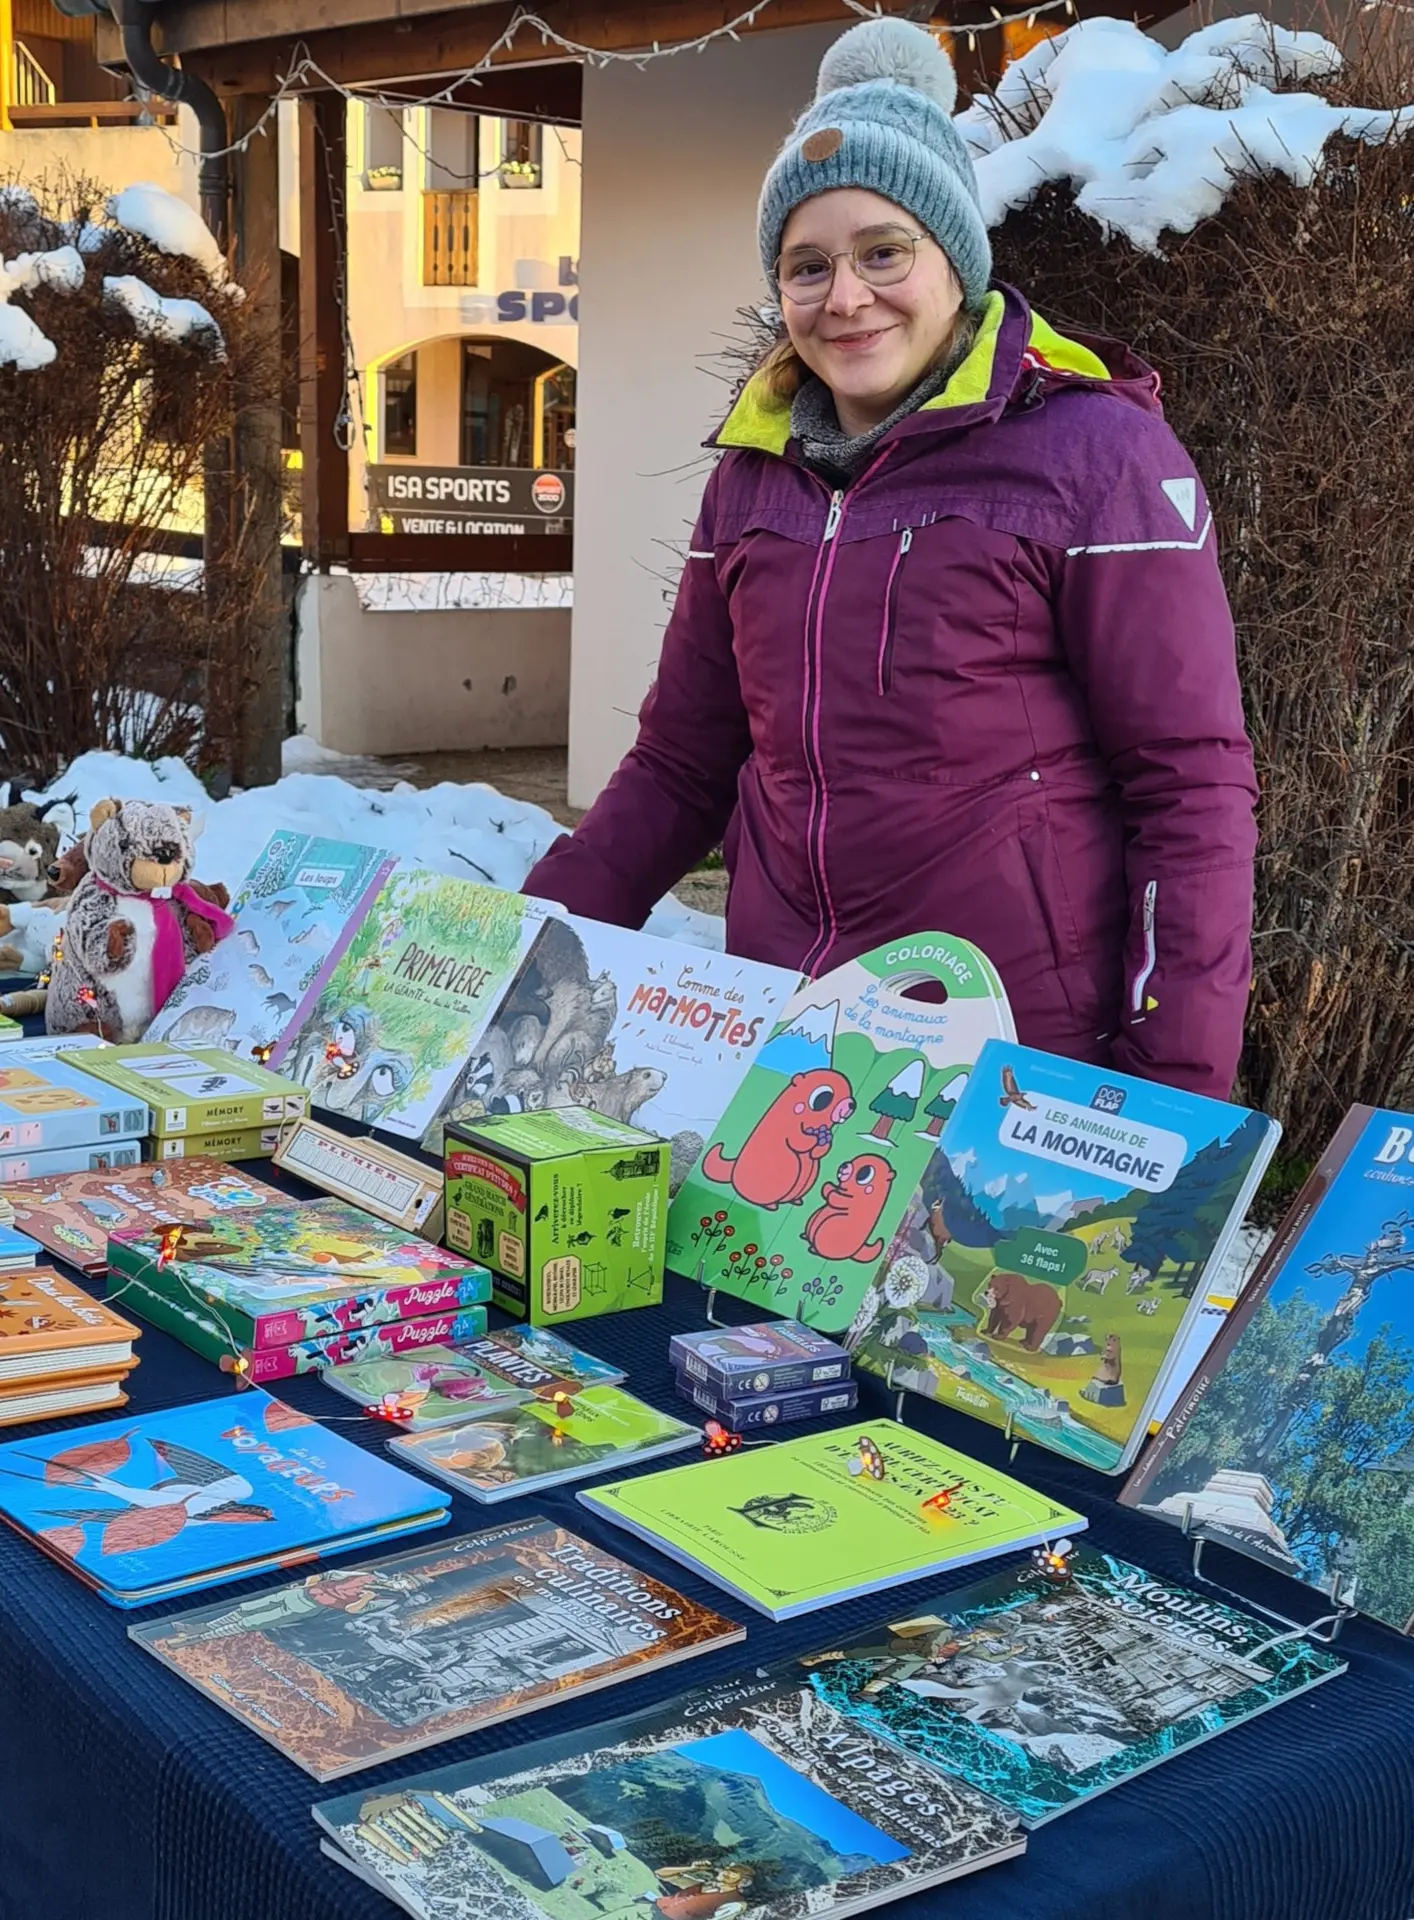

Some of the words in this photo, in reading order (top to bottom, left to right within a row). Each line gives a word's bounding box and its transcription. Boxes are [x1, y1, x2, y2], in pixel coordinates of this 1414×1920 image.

[388, 476, 422, 498] ISA
[425, 478, 510, 502] SPORTS
[402, 518, 442, 534] VENTE
[300, 872, 314, 883] Les
[316, 873, 338, 886] loups
[677, 964, 721, 998] Comme
[724, 986, 745, 1004] des
[886, 945, 972, 984] COLORIAGE
[858, 984, 880, 1009] Les
[881, 1003, 948, 1024] animaux
[844, 1002, 858, 1021] de
[858, 1010, 872, 1030] la
[875, 1024, 944, 1050] montagne
[206, 1106, 244, 1117] MÉMORY
[1094, 1098, 1120, 1111] FLAP
[1098, 1088, 1124, 1104] DOC
[204, 1136, 242, 1148] MÉMORY
[1044, 1108, 1068, 1125] LES
[1070, 1116, 1128, 1142] ANIMAUX
[1130, 1133, 1149, 1149] DE
[316, 1139, 398, 1182] PLUMIER
[1011, 1121, 1038, 1144] LA
[1040, 1131, 1164, 1183] MONTAGNE
[552, 1174, 560, 1244] Arriverez-vous
[633, 1202, 642, 1248] Retrouvez
[1020, 1254, 1034, 1266] 36
[1034, 1242, 1059, 1256] Avec
[404, 1282, 454, 1305] Puzzle
[460, 1284, 474, 1297] 24
[398, 1320, 448, 1342] Puzzle
[454, 1322, 469, 1336] 24
[464, 1340, 552, 1383] PLANTES
[702, 1532, 747, 1562] LAROUSSE
[548, 1543, 682, 1621] Traditions
[513, 1574, 535, 1588] en
[534, 1587, 614, 1634] montagne
[535, 1568, 668, 1642] culinaires
[1111, 1572, 1250, 1644] Moulins,
[684, 1680, 778, 1718] Colporteur
[758, 1717, 835, 1774] coutumes
[838, 1776, 856, 1793] et
[858, 1786, 944, 1850] traditions
[817, 1732, 946, 1816] Alpages
